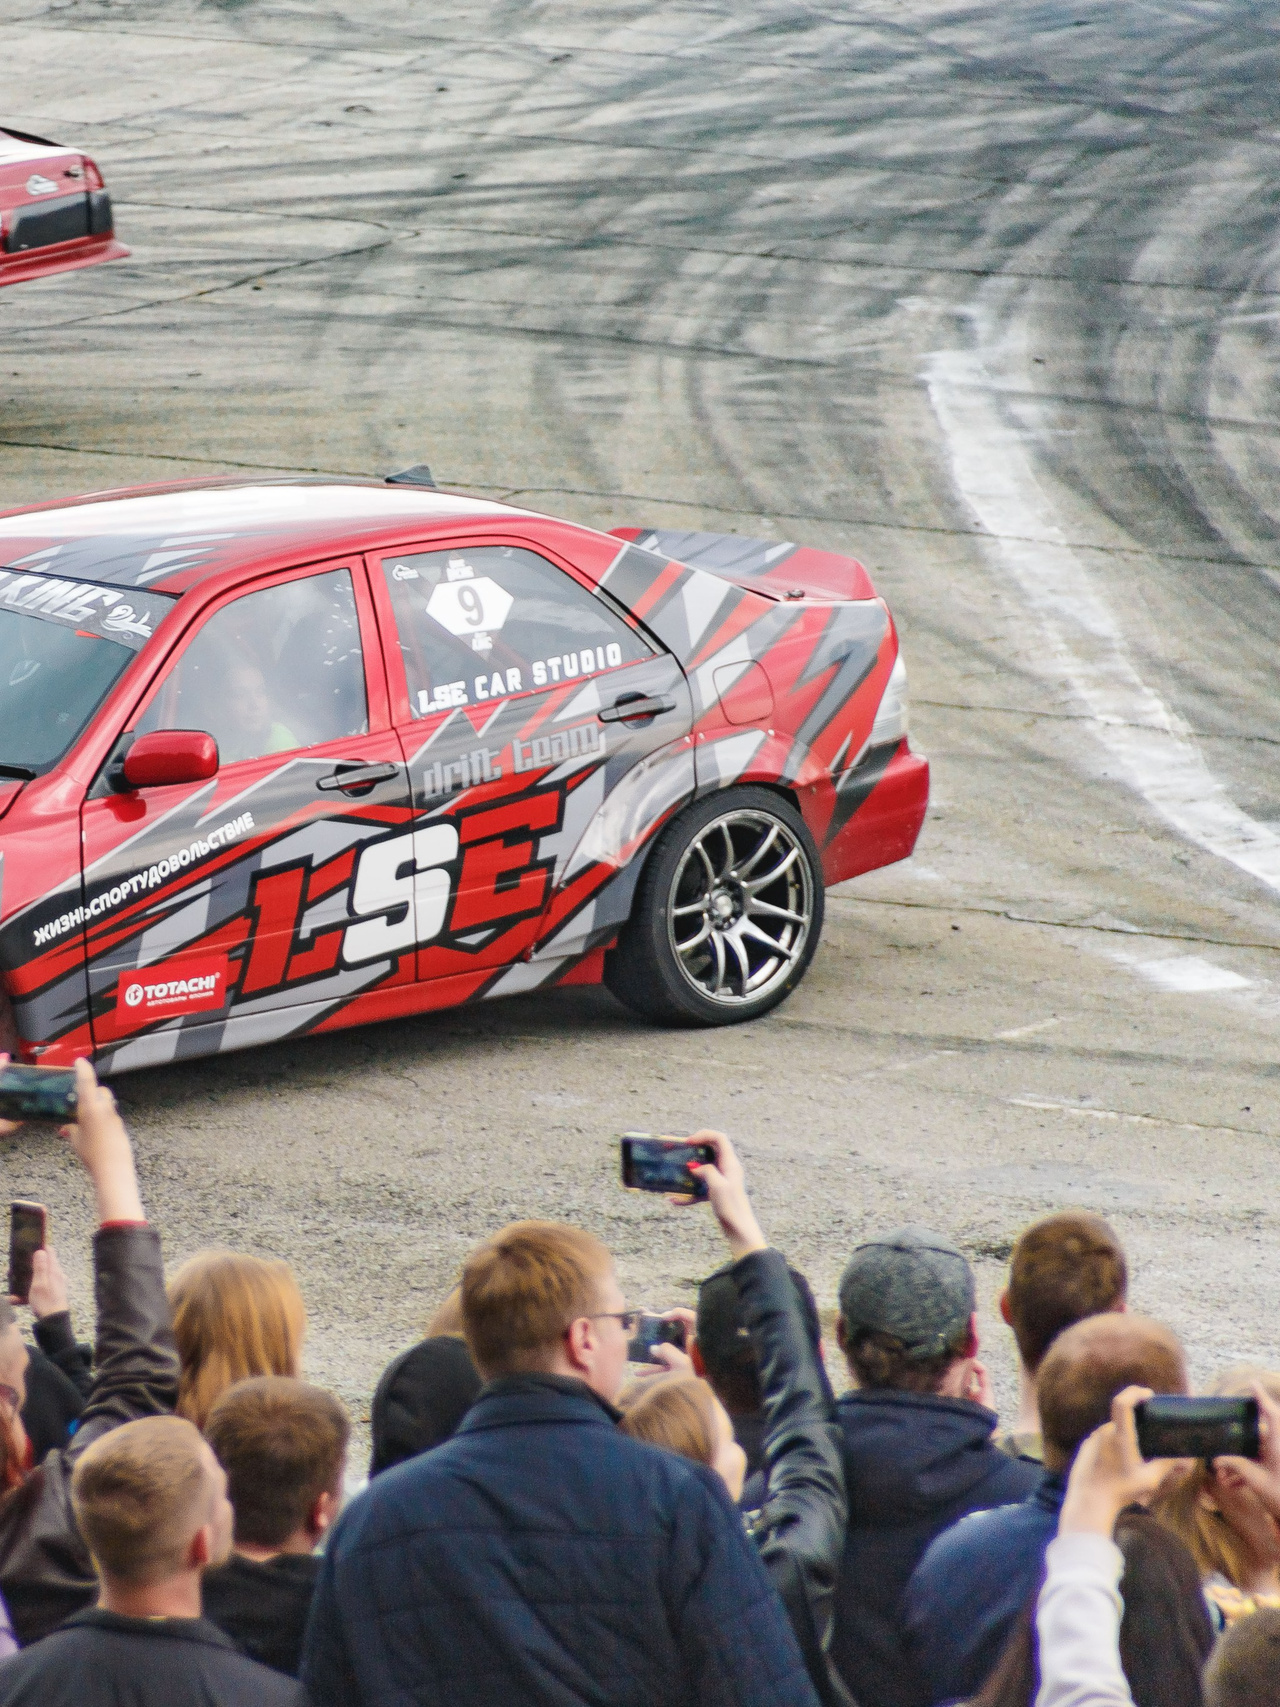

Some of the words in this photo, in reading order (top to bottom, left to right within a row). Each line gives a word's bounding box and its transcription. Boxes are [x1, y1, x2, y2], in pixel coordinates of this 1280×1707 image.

[457, 585, 484, 626] 9
[417, 680, 468, 714] LSE
[474, 667, 522, 700] CAR
[532, 642, 622, 685] STUDIO
[423, 748, 502, 800] drift
[511, 722, 600, 774] team
[240, 790, 562, 995] LSE
[144, 975, 216, 998] TOTACHI
